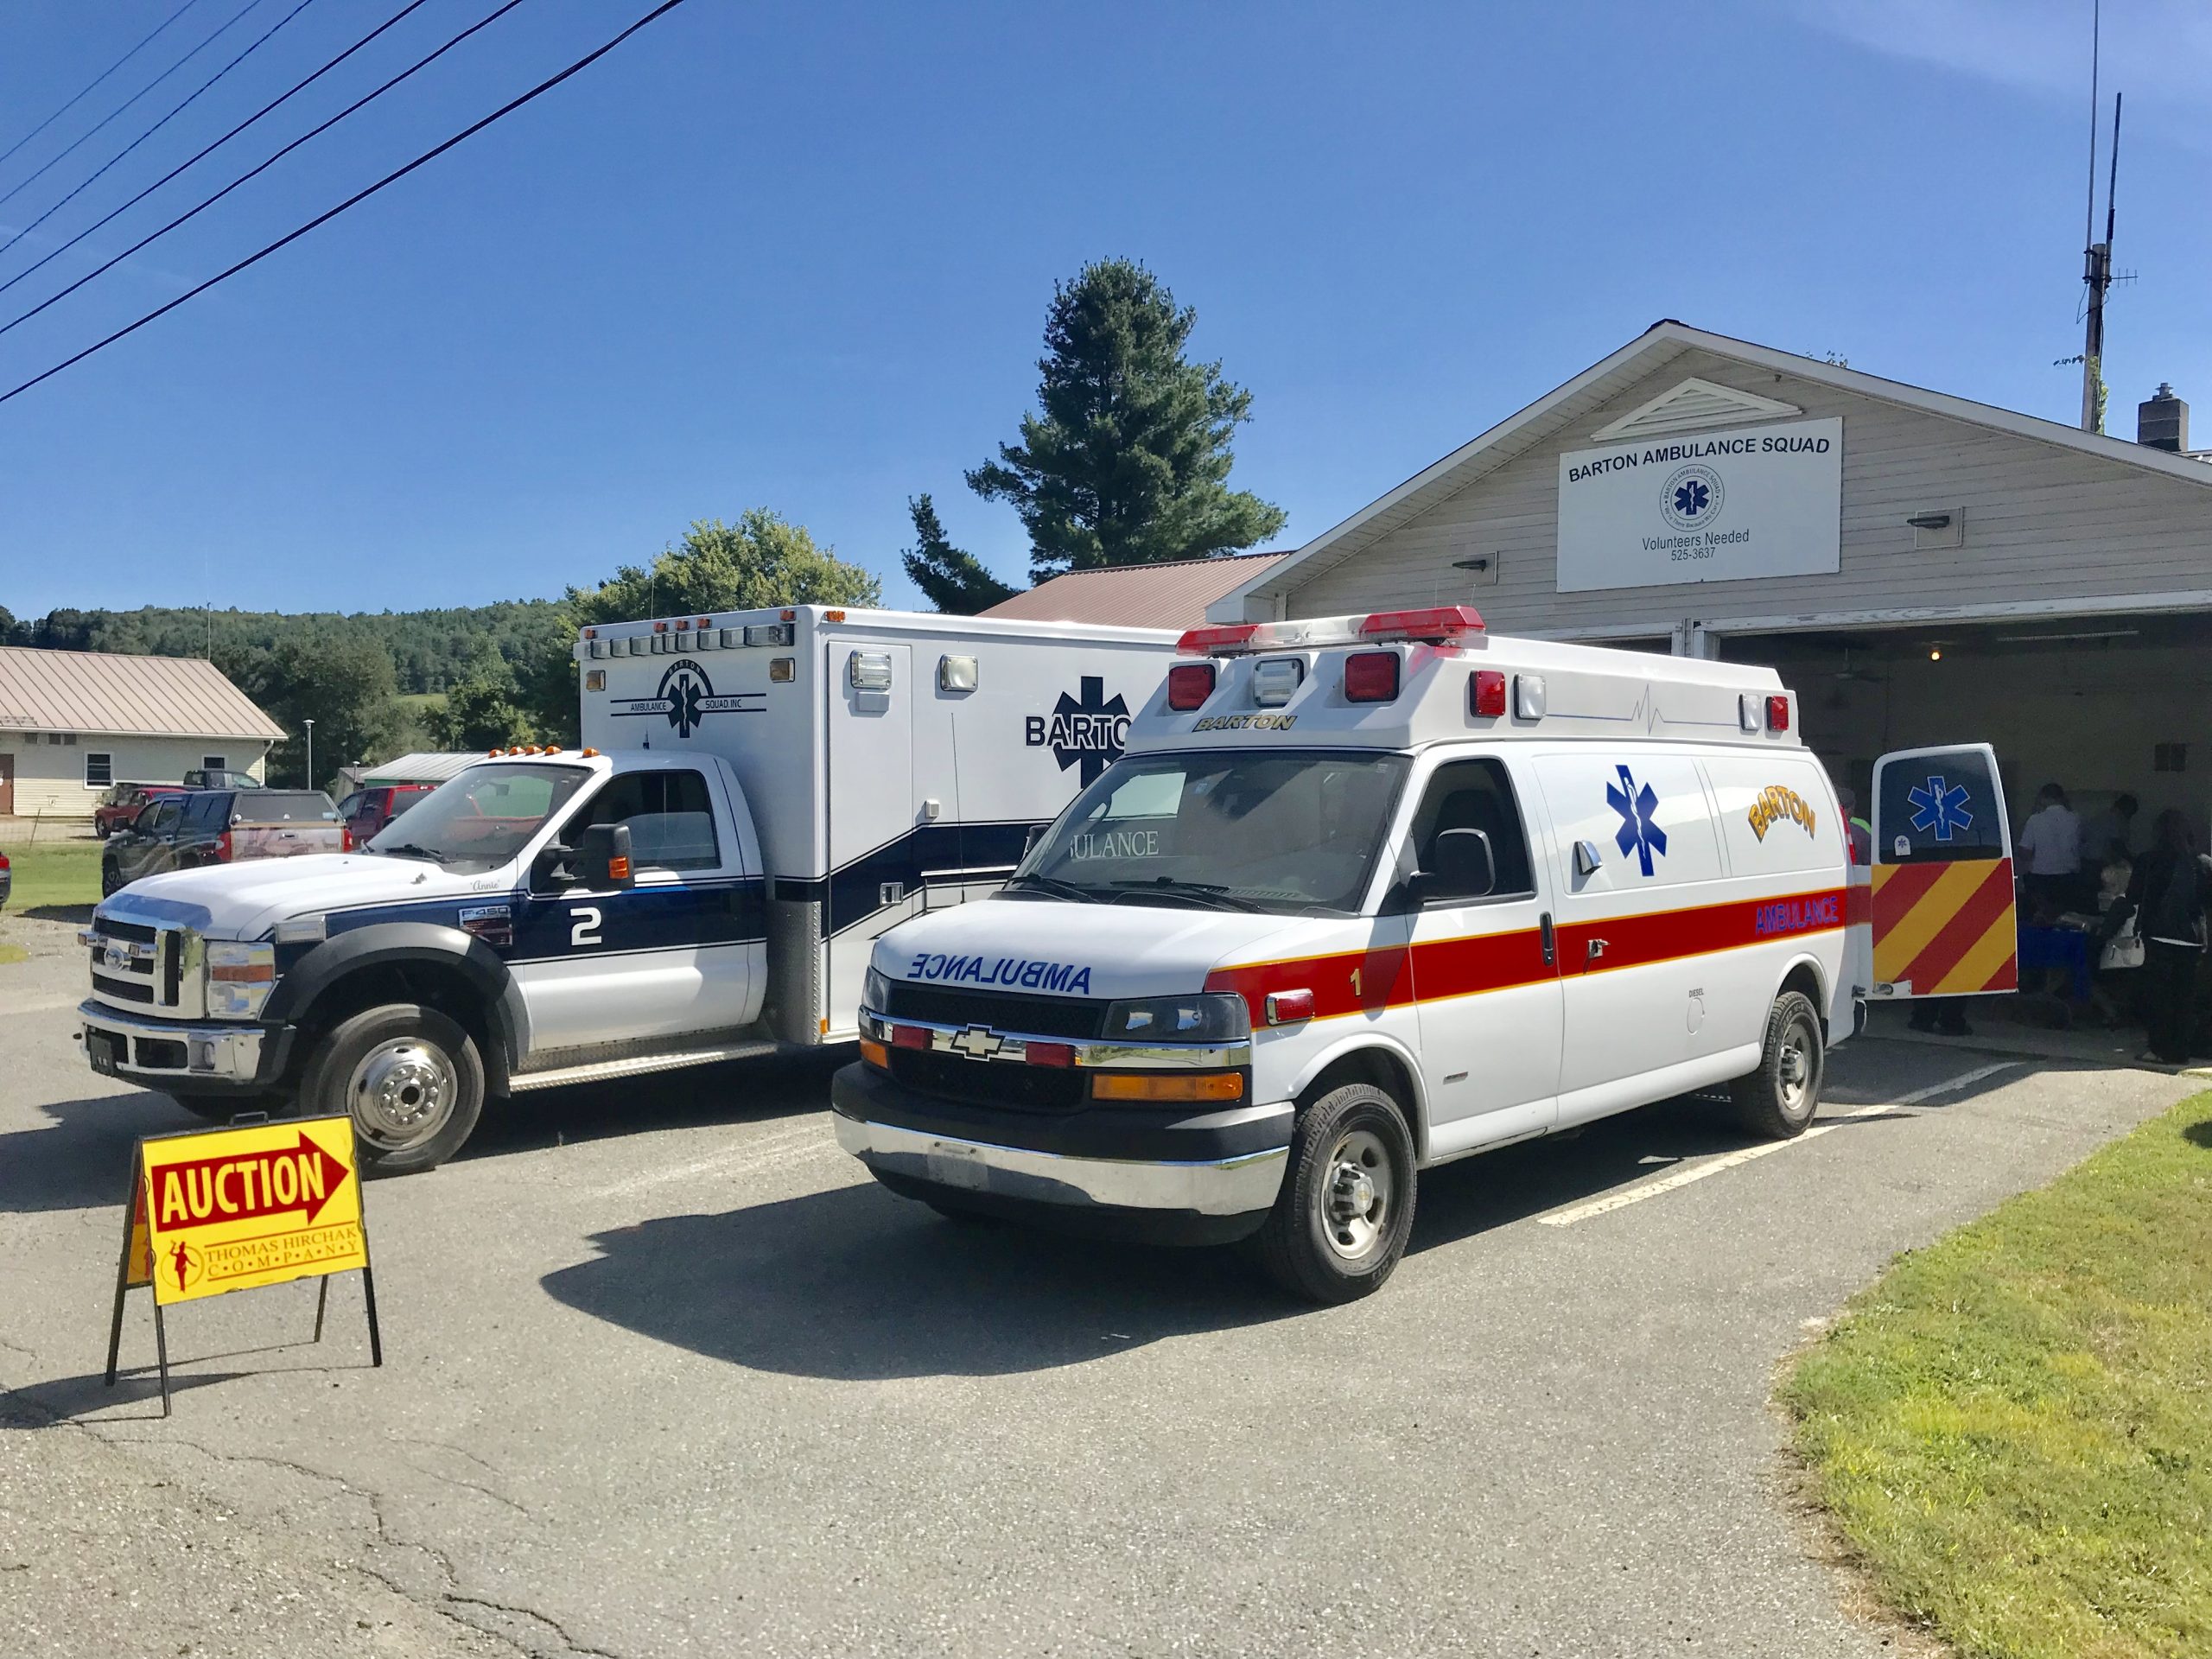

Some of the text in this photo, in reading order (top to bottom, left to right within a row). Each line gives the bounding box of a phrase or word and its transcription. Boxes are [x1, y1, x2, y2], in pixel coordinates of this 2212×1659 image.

[1569, 437, 1830, 482] BARTON AMBULANCE SQUAD
[1663, 468, 1721, 499] BARTON AMBULANCE SQUAD
[1642, 529, 1750, 550] Volunteers Needed
[1671, 546, 1716, 561] 525-3637
[668, 660, 701, 675] BARTON
[630, 702, 666, 711] AMBULANCE
[1026, 714, 1132, 749] BARTO
[1192, 715, 1298, 733] BARTON
[1748, 785, 1815, 843] BARTON
[461, 907, 508, 917] F-450
[570, 906, 602, 946] 2
[1756, 895, 1839, 935] AMBULANCE
[1350, 968, 1361, 996] 1
[1688, 988, 1704, 998] DIESEL
[162, 1152, 325, 1224] AUCTION
[205, 1227, 357, 1263] THOMAS HIRCHAK
